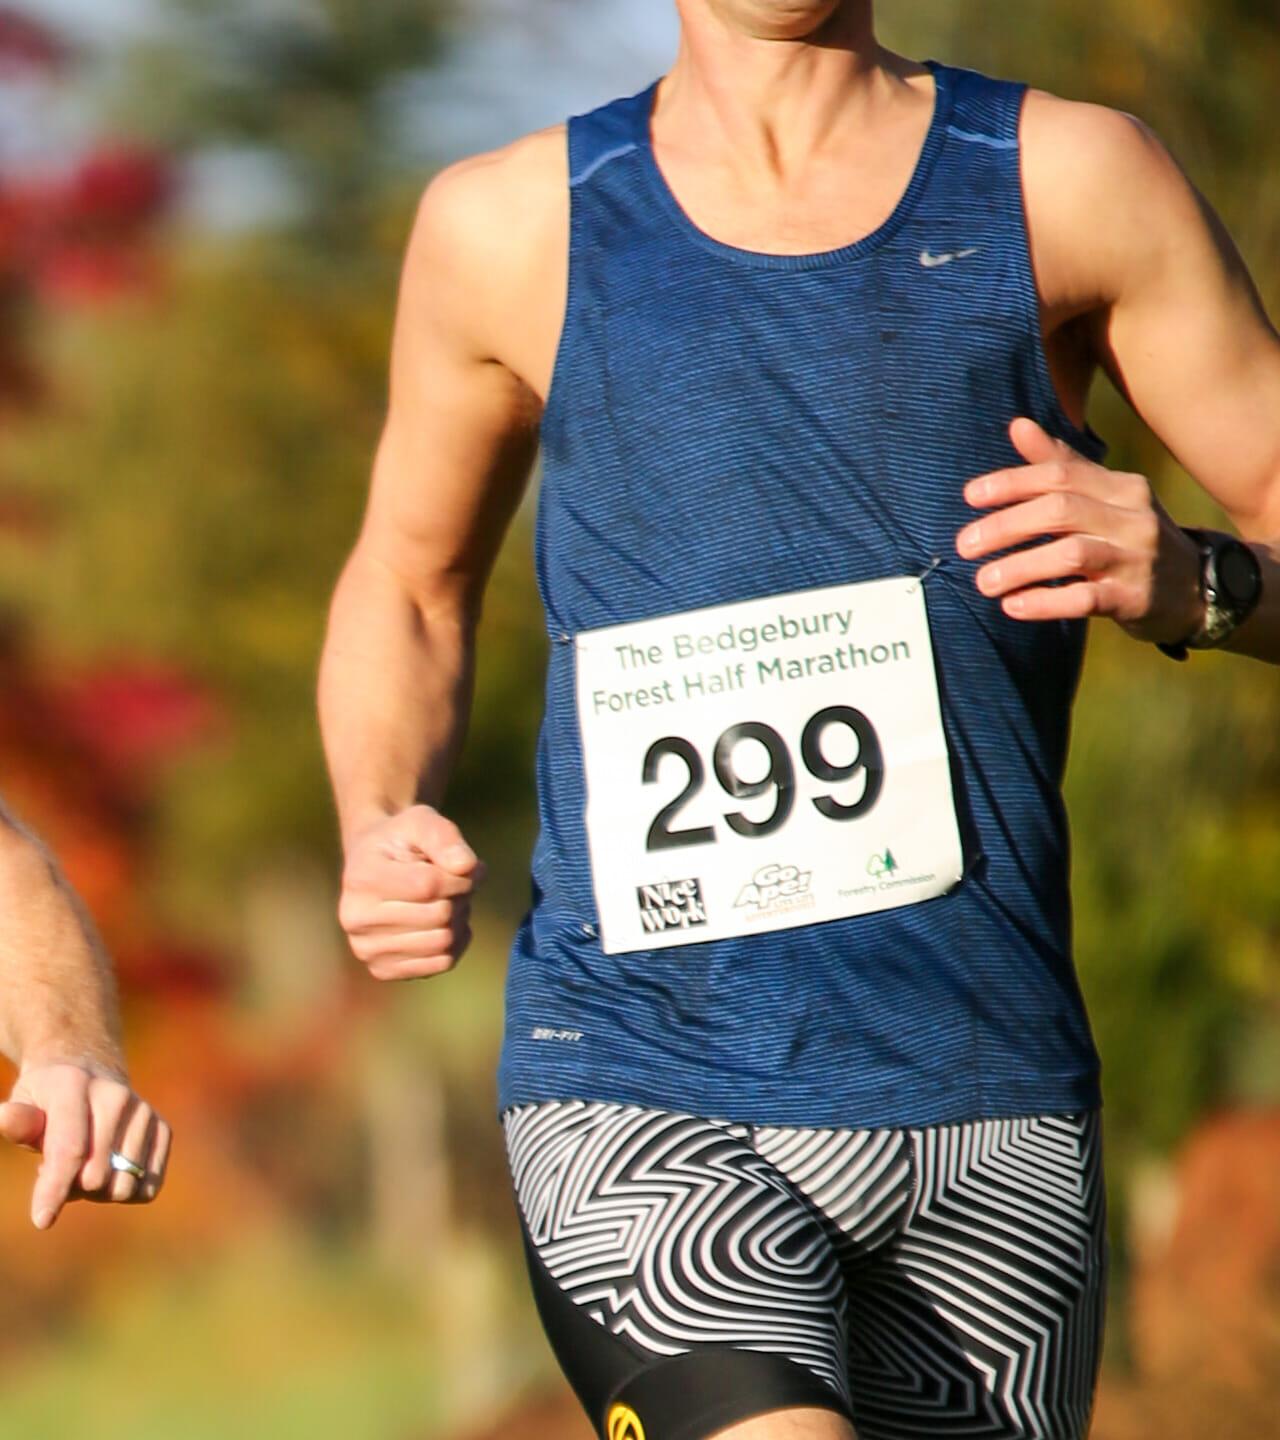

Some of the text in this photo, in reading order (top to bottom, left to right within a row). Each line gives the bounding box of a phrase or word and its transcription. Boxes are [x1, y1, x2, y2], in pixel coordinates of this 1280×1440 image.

[615, 609, 854, 670] The Bedgebury
[593, 638, 912, 715] Forest Half Marathon
[642, 705, 886, 853] 299
[752, 863, 800, 888] Go
